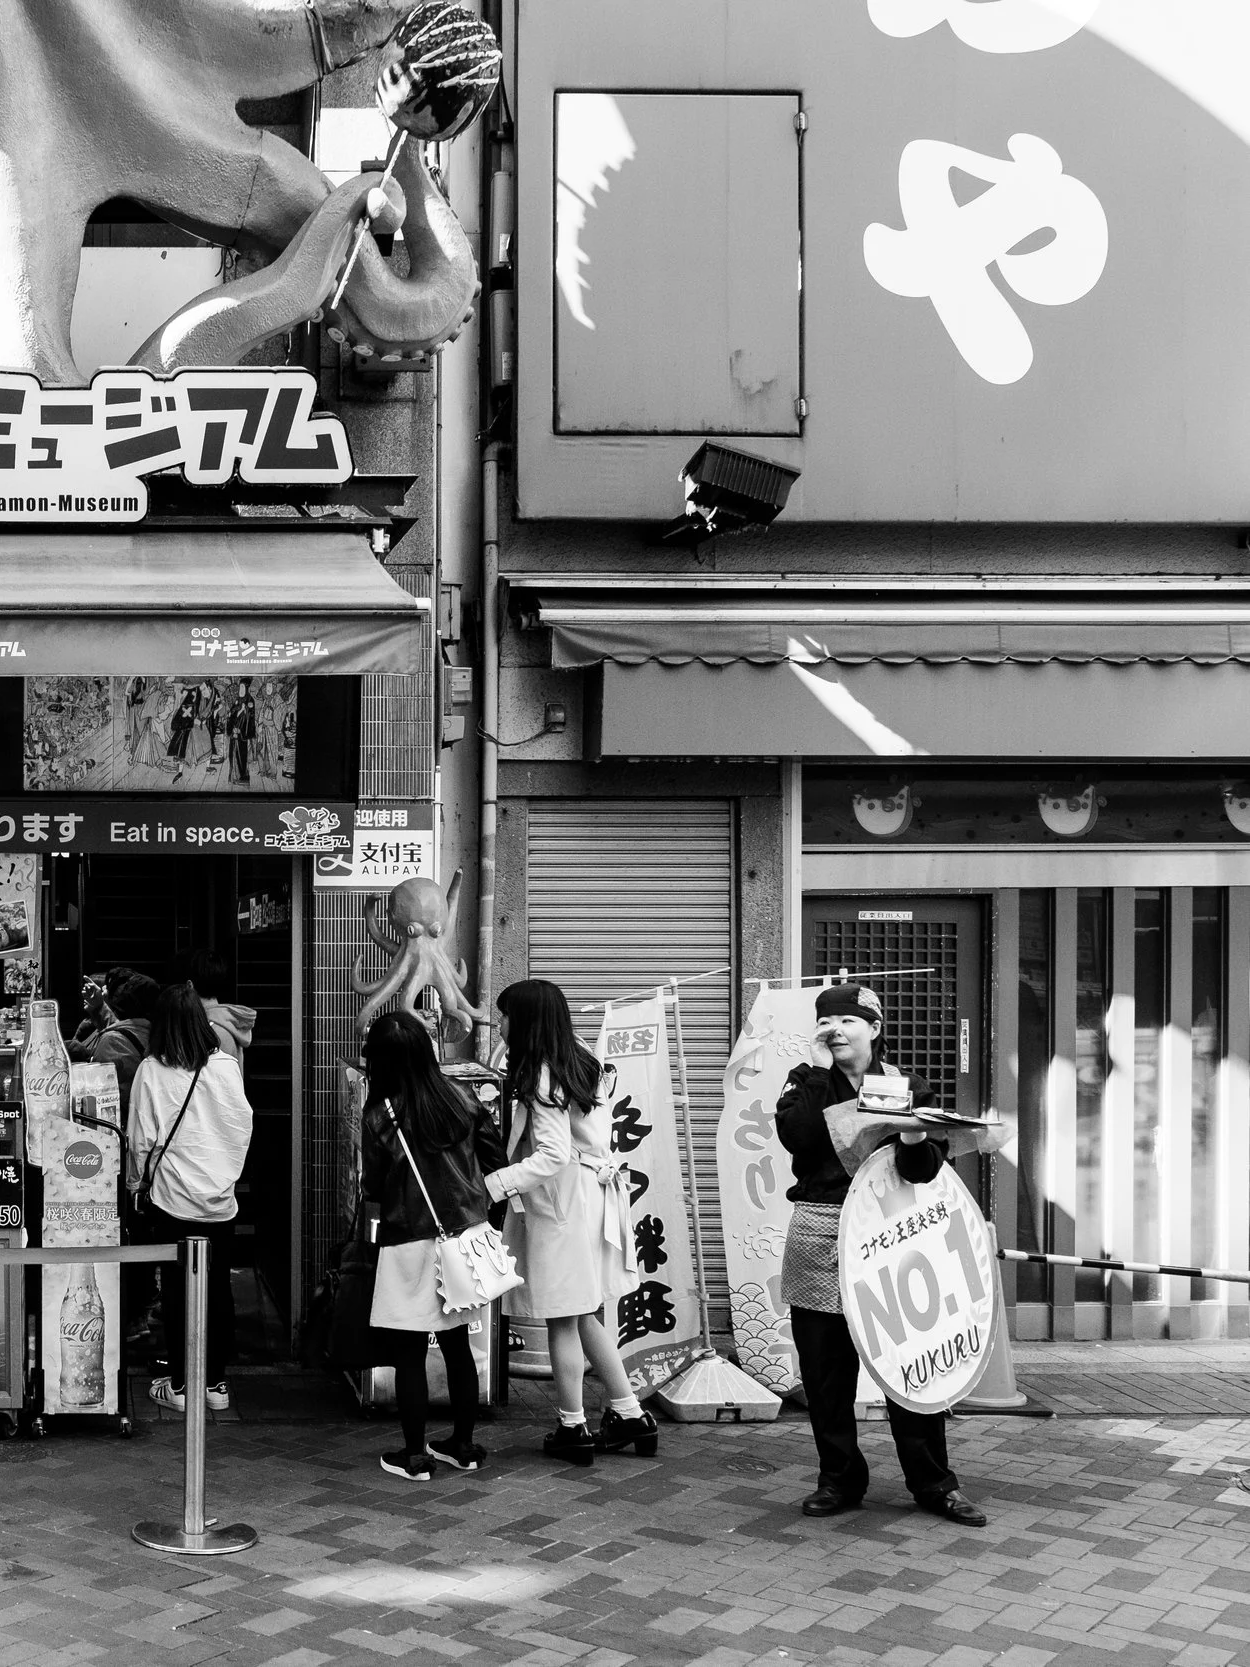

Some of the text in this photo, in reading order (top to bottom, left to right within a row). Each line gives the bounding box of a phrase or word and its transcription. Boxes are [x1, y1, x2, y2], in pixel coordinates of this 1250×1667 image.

[190, 635, 329, 658] コナモンミュージアム
[110, 822, 150, 842] Eat
[157, 822, 177, 842] in
[185, 825, 261, 846] space.
[359, 842, 422, 863] 支付宝
[361, 865, 421, 875] ALIPAY
[65, 1152, 99, 1167] Coca-Cola
[46, 1207, 120, 1222] 桜咲く春限定
[860, 1200, 950, 1261] コナモン王座決定戦
[853, 1208, 986, 1361] NO.1
[899, 1324, 981, 1394] KUKURU
